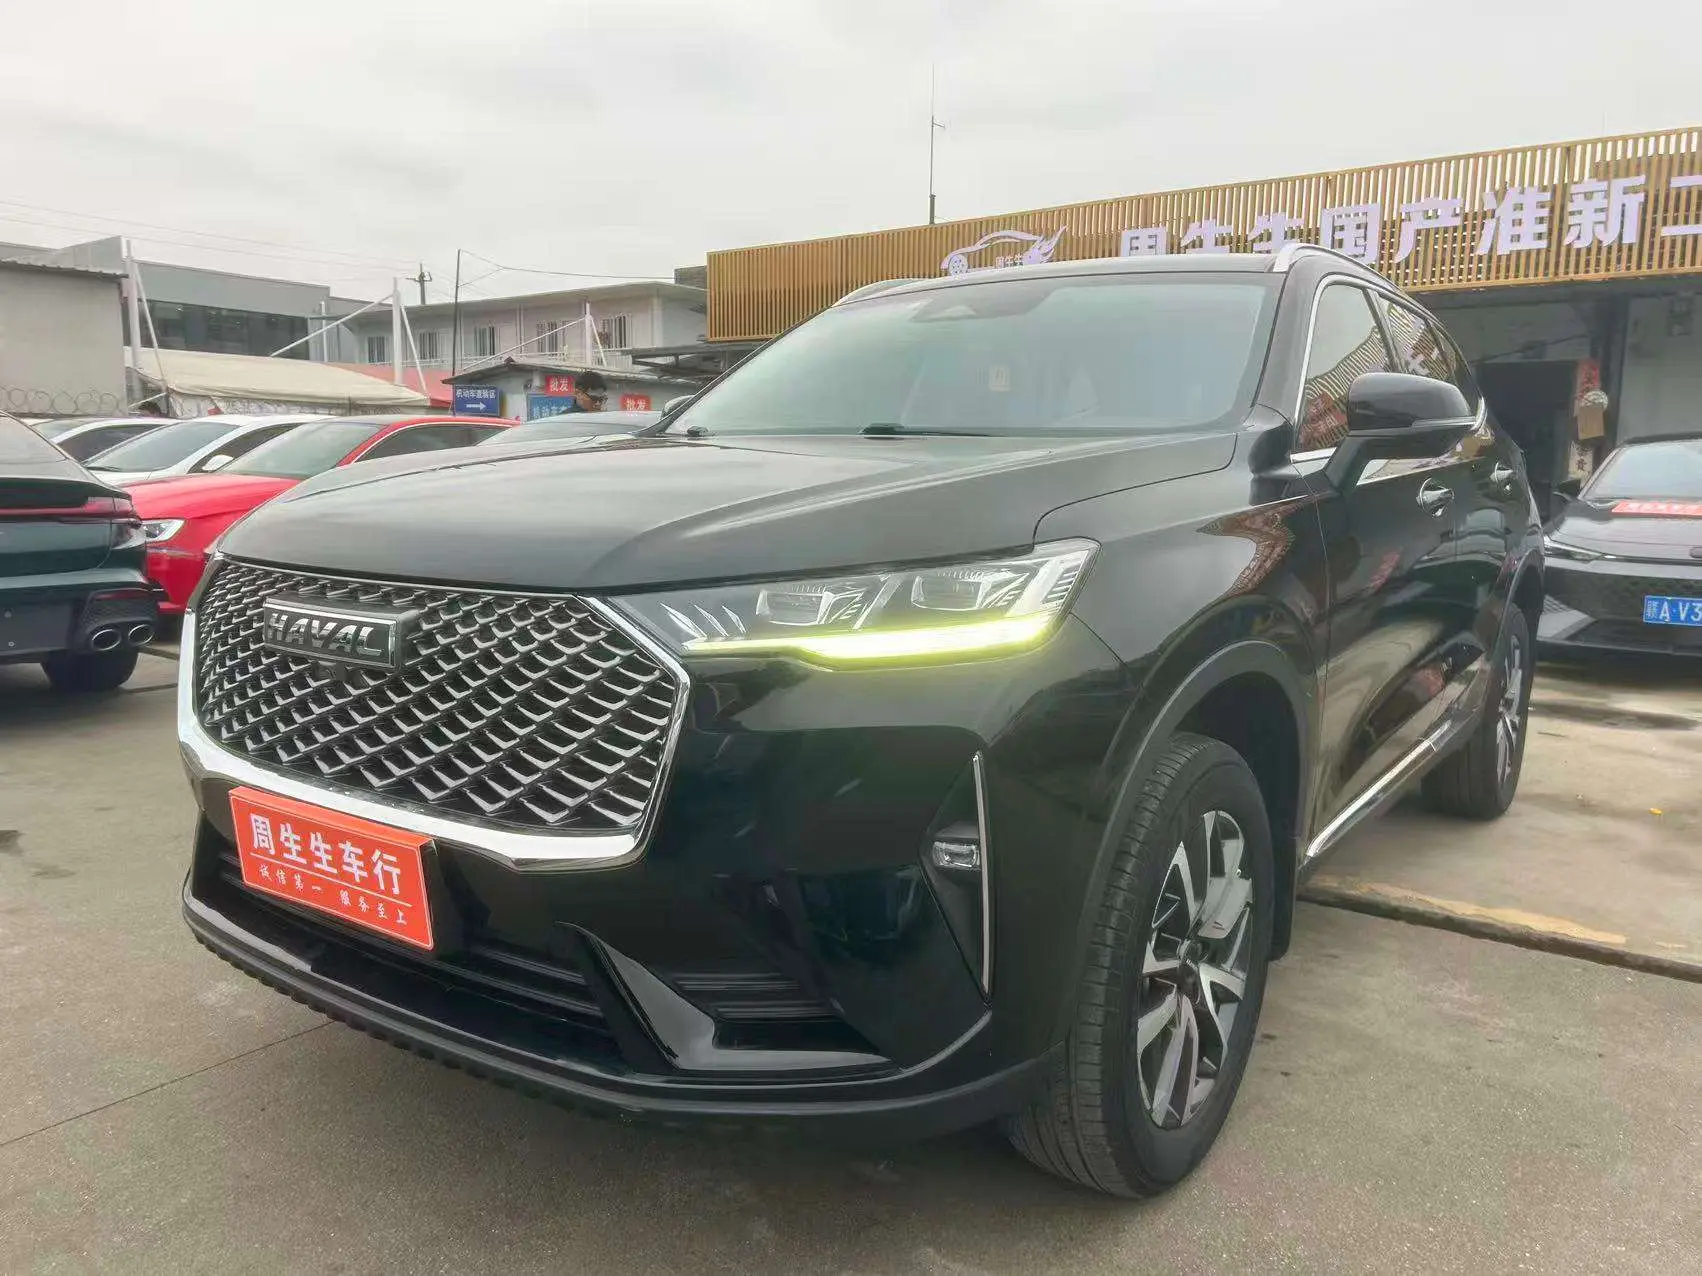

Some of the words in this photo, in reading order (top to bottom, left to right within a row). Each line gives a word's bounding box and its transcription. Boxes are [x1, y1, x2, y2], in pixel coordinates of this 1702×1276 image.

[550, 377, 568, 392] 批发
[267, 611, 384, 657] HAVAL
[250, 812, 401, 895] 周生生车行
[339, 889, 407, 925] 服务至上
